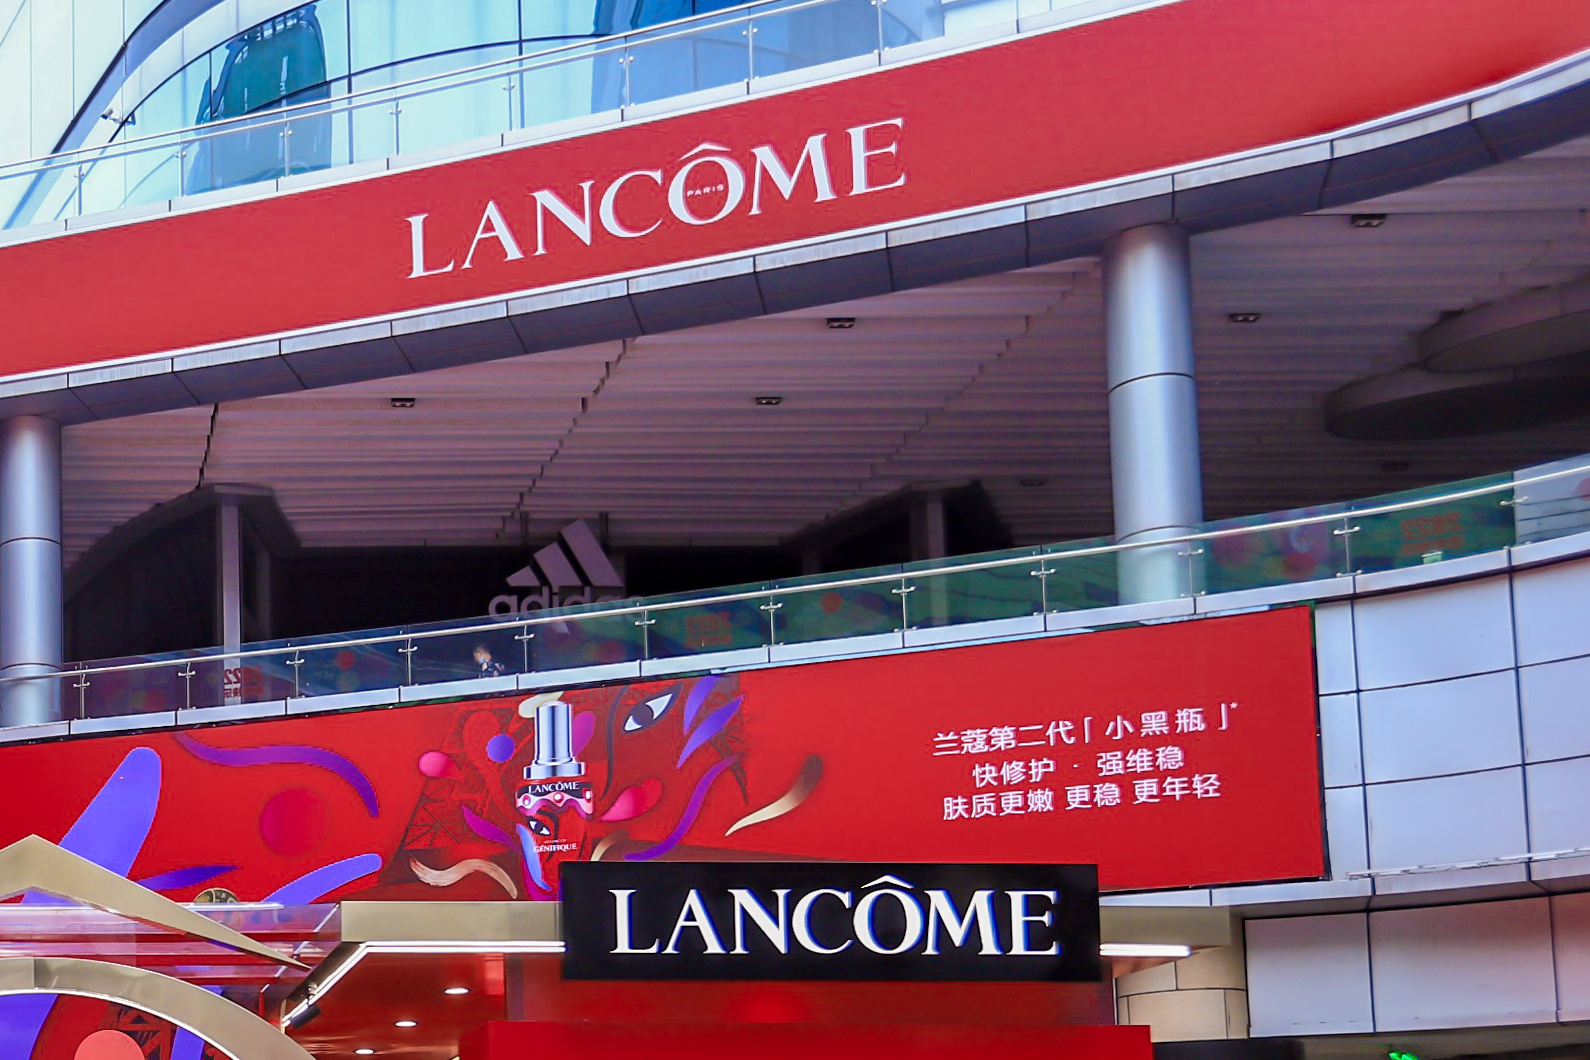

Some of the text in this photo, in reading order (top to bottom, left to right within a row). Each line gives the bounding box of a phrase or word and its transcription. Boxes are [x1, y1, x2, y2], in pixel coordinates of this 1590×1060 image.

[406, 117, 907, 279] LANCÔME
[687, 184, 724, 197] PARIS
[528, 781, 580, 794] LANCÔME
[972, 757, 1056, 789] 快修护
[1097, 745, 1185, 777] 强维稳
[942, 773, 1222, 821] 肤质更嫩 更稳 更年轻
[608, 874, 1061, 956] LANCÔME
